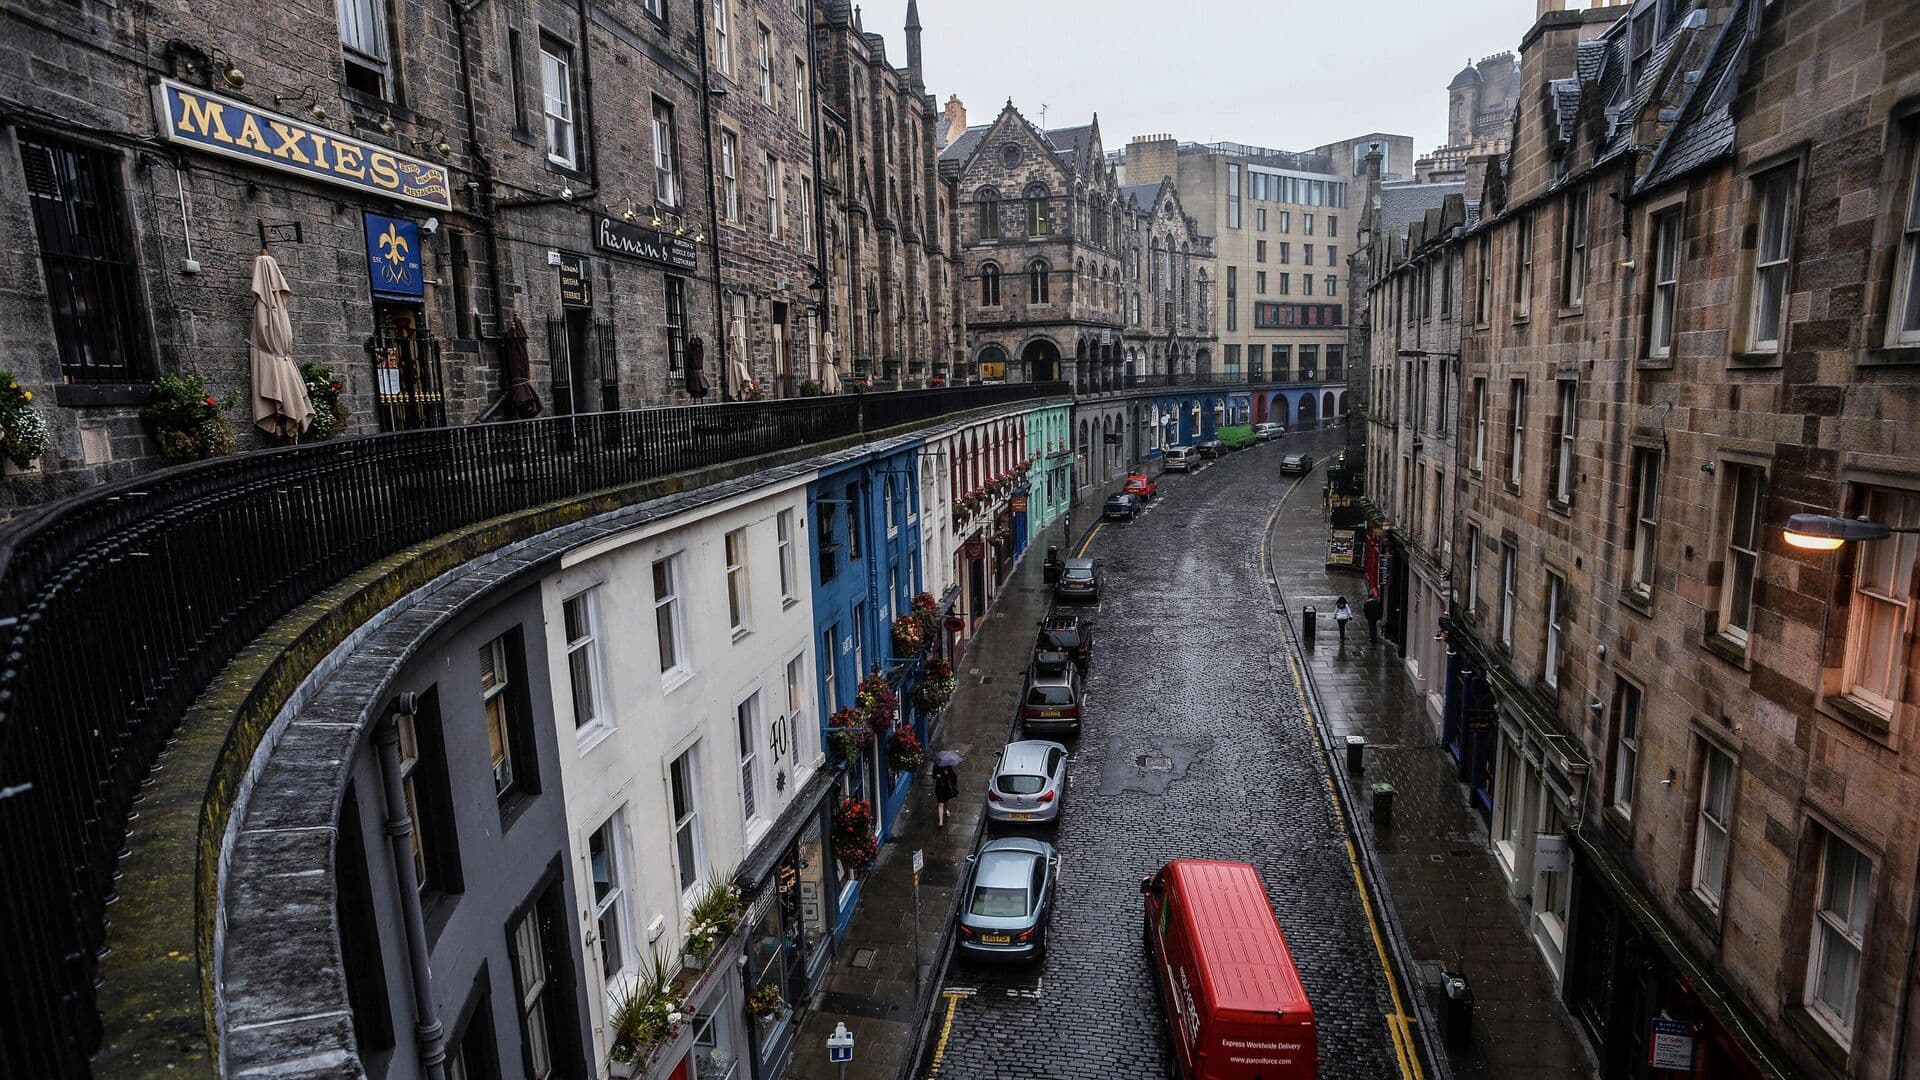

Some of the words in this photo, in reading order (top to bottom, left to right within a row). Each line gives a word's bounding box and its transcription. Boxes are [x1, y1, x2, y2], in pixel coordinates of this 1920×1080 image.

[178, 92, 400, 189] MAXIES
[770, 715, 787, 765] 40
[1222, 1039, 1246, 1048] Express
[1246, 1041, 1277, 1050] Worldwide
[1278, 1042, 1301, 1051] Delivery
